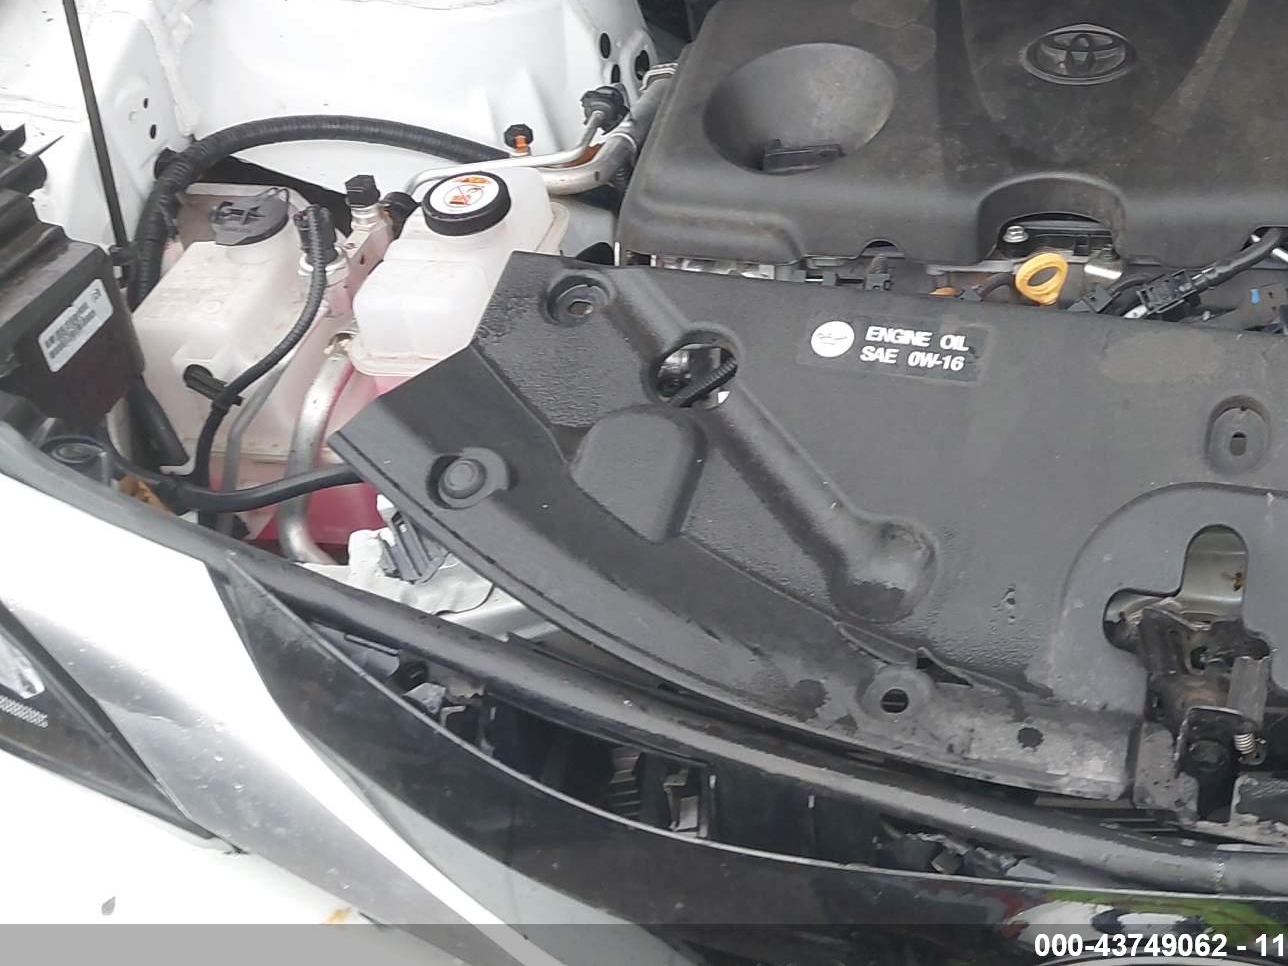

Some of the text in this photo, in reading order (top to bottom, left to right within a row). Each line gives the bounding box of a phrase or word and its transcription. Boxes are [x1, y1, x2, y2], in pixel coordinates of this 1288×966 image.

[865, 325, 970, 351] ENGINE OIL
[859, 345, 965, 371] SAE 0W-16
